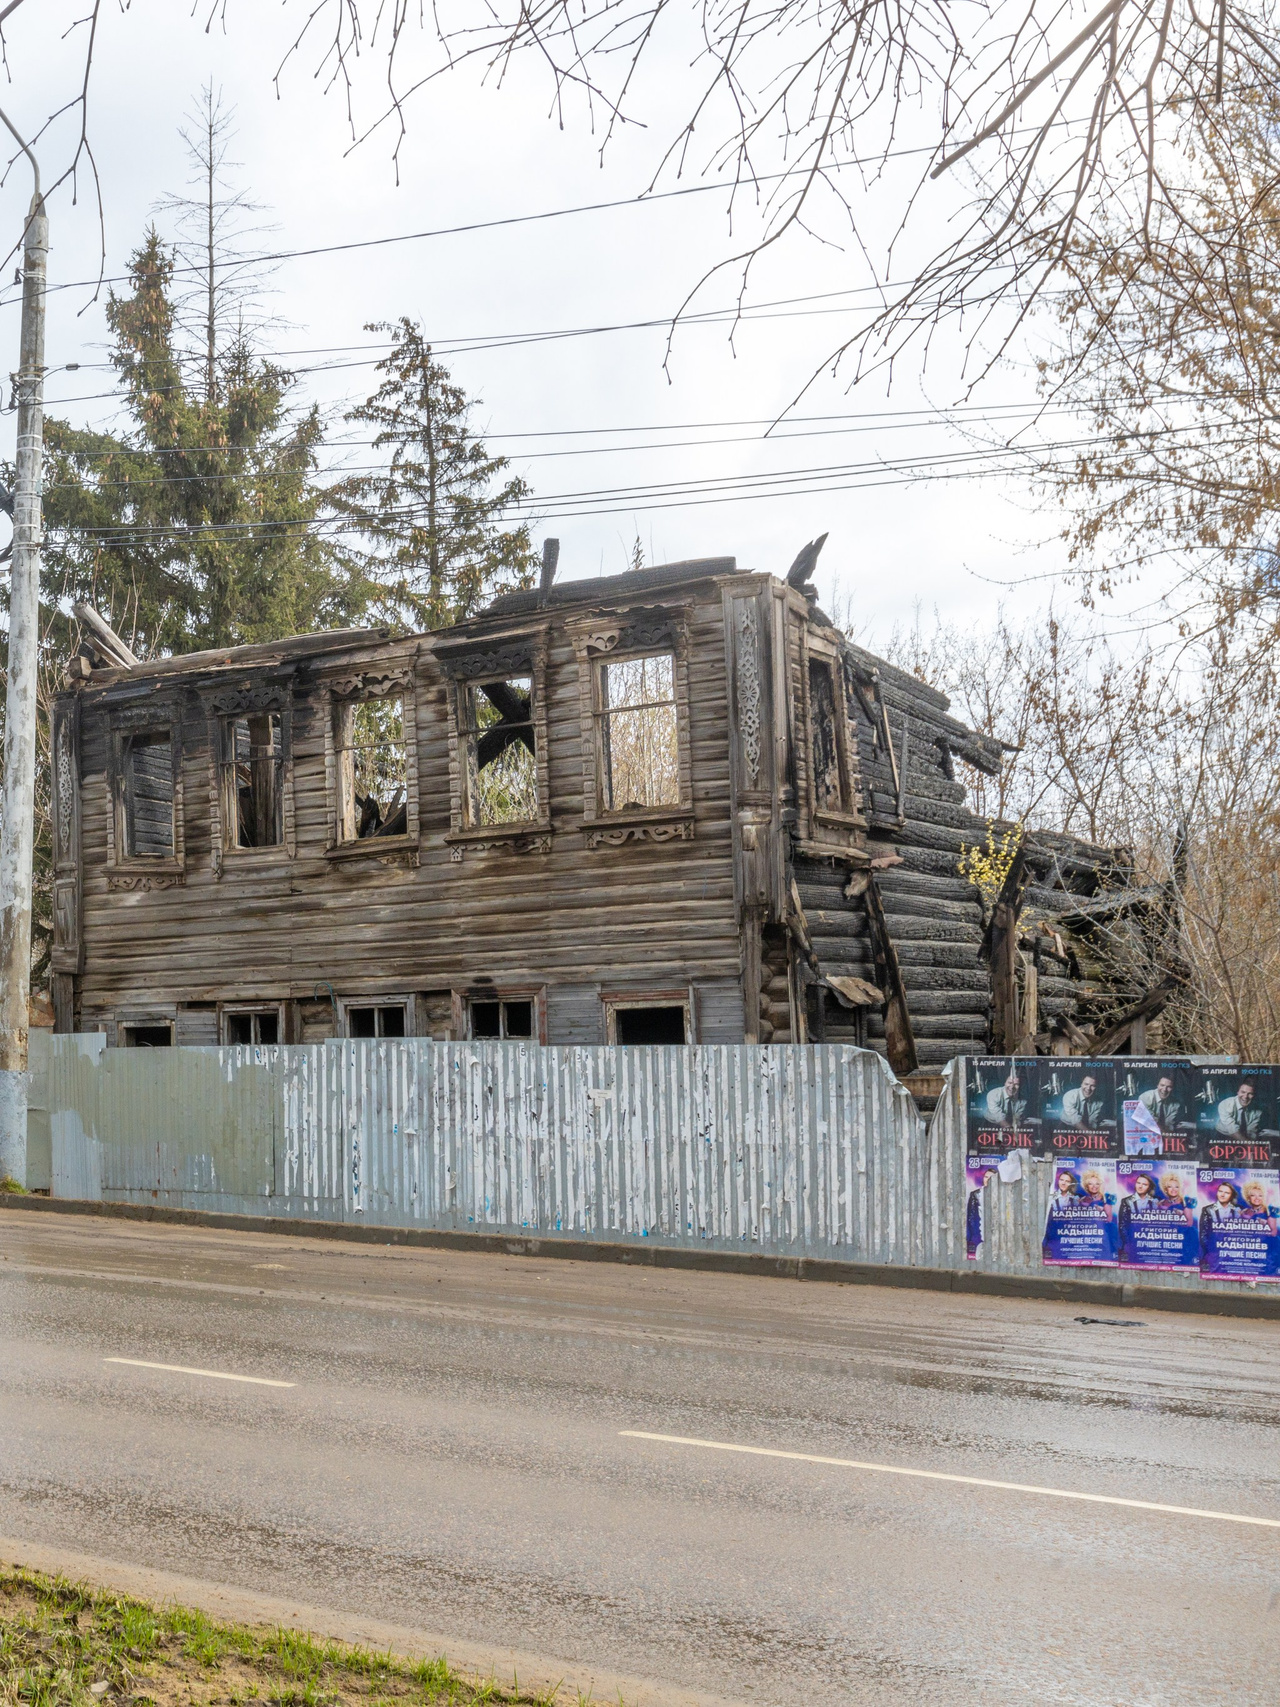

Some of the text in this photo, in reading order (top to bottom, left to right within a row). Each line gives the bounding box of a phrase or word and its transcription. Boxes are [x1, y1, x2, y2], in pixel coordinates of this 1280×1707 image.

[978, 1133, 1033, 1147] ФРЭНК
[1053, 1135, 1109, 1149] ФРЭНК
[1209, 1146, 1269, 1161] ФРЭНК
[970, 1158, 979, 1168] 25
[1120, 1164, 1131, 1173] 25
[1201, 1171, 1212, 1181] 25
[1053, 1210, 1107, 1218] КАДЫШЕВА
[1130, 1213, 1187, 1221] КАДЫШЕВА
[1212, 1222, 1271, 1231] КАДЫШЕВА
[1134, 1232, 1184, 1240] КАДЫШЕВ
[1136, 1240, 1183, 1249] ЛУЧШИЕ ПЕСНИ
[1216, 1242, 1268, 1250] КАДЫШЕВ
[1219, 1250, 1266, 1259] ЛУЧШИЕ ПЕСНИ
